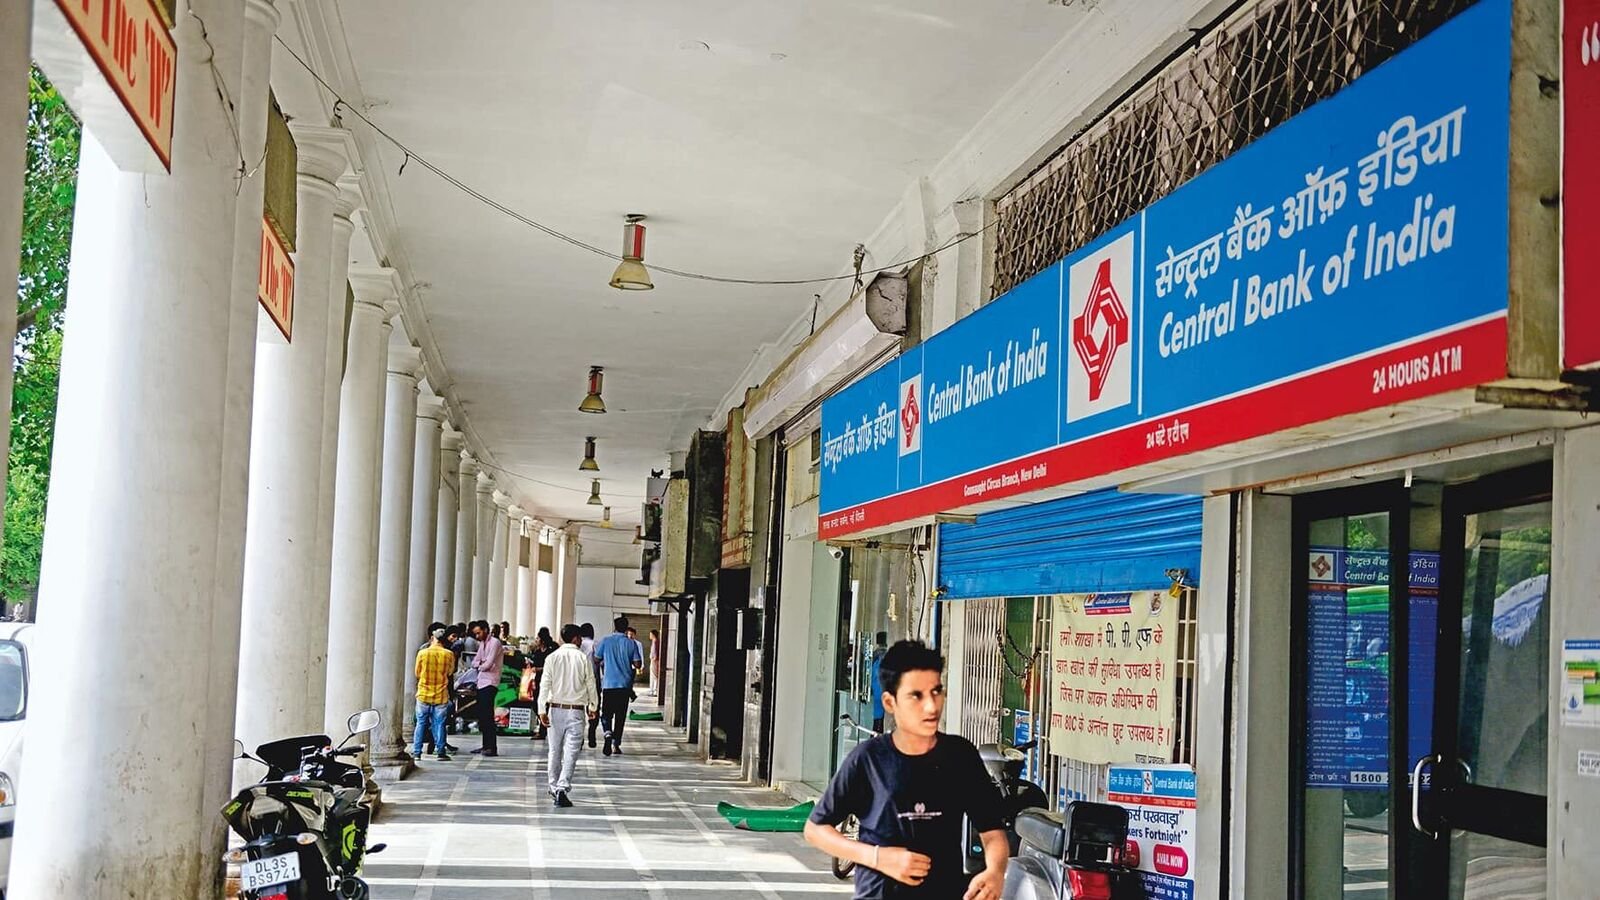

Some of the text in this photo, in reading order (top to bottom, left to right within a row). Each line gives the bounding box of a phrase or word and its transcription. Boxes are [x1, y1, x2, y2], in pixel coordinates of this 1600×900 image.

[1155, 232, 1223, 299] सेन्ट्रल
[1226, 203, 1275, 261] बैंक
[1358, 105, 1466, 208] इंडिया
[1158, 193, 1456, 358] Central Bank of India
[927, 328, 1048, 425] Central Bank of India
[1372, 345, 1462, 394] 24 HOURS ATM
[843, 420, 856, 459] बैंक
[873, 401, 897, 451] इंडिया
[1146, 432, 1155, 449] 24
[1021, 468, 1033, 482] New
[1033, 462, 1047, 479] Delhi
[1344, 570, 1376, 582] Central
[1377, 572, 1389, 582] Ba
[1414, 574, 1436, 584] India
[1088, 656, 1099, 678] की
[1101, 657, 1121, 685] सुविधा
[1124, 663, 1152, 680] उपलब्ध
[1060, 681, 1073, 702] जिस
[1075, 689, 1084, 704] पर
[1111, 687, 1144, 710] अधिनियम
[1146, 687, 1158, 711] की
[1113, 723, 1124, 745] छूट
[1127, 725, 1154, 743] उपलब्ध
[1155, 777, 1168, 789] Central
[1168, 777, 1178, 790] Bank
[1183, 777, 1195, 791] India
[1354, 772, 1382, 784] 1800
[255, 857, 287, 874] DL3S
[1156, 852, 1184, 868] AVAIL NOW
[249, 866, 297, 887] BS9741
